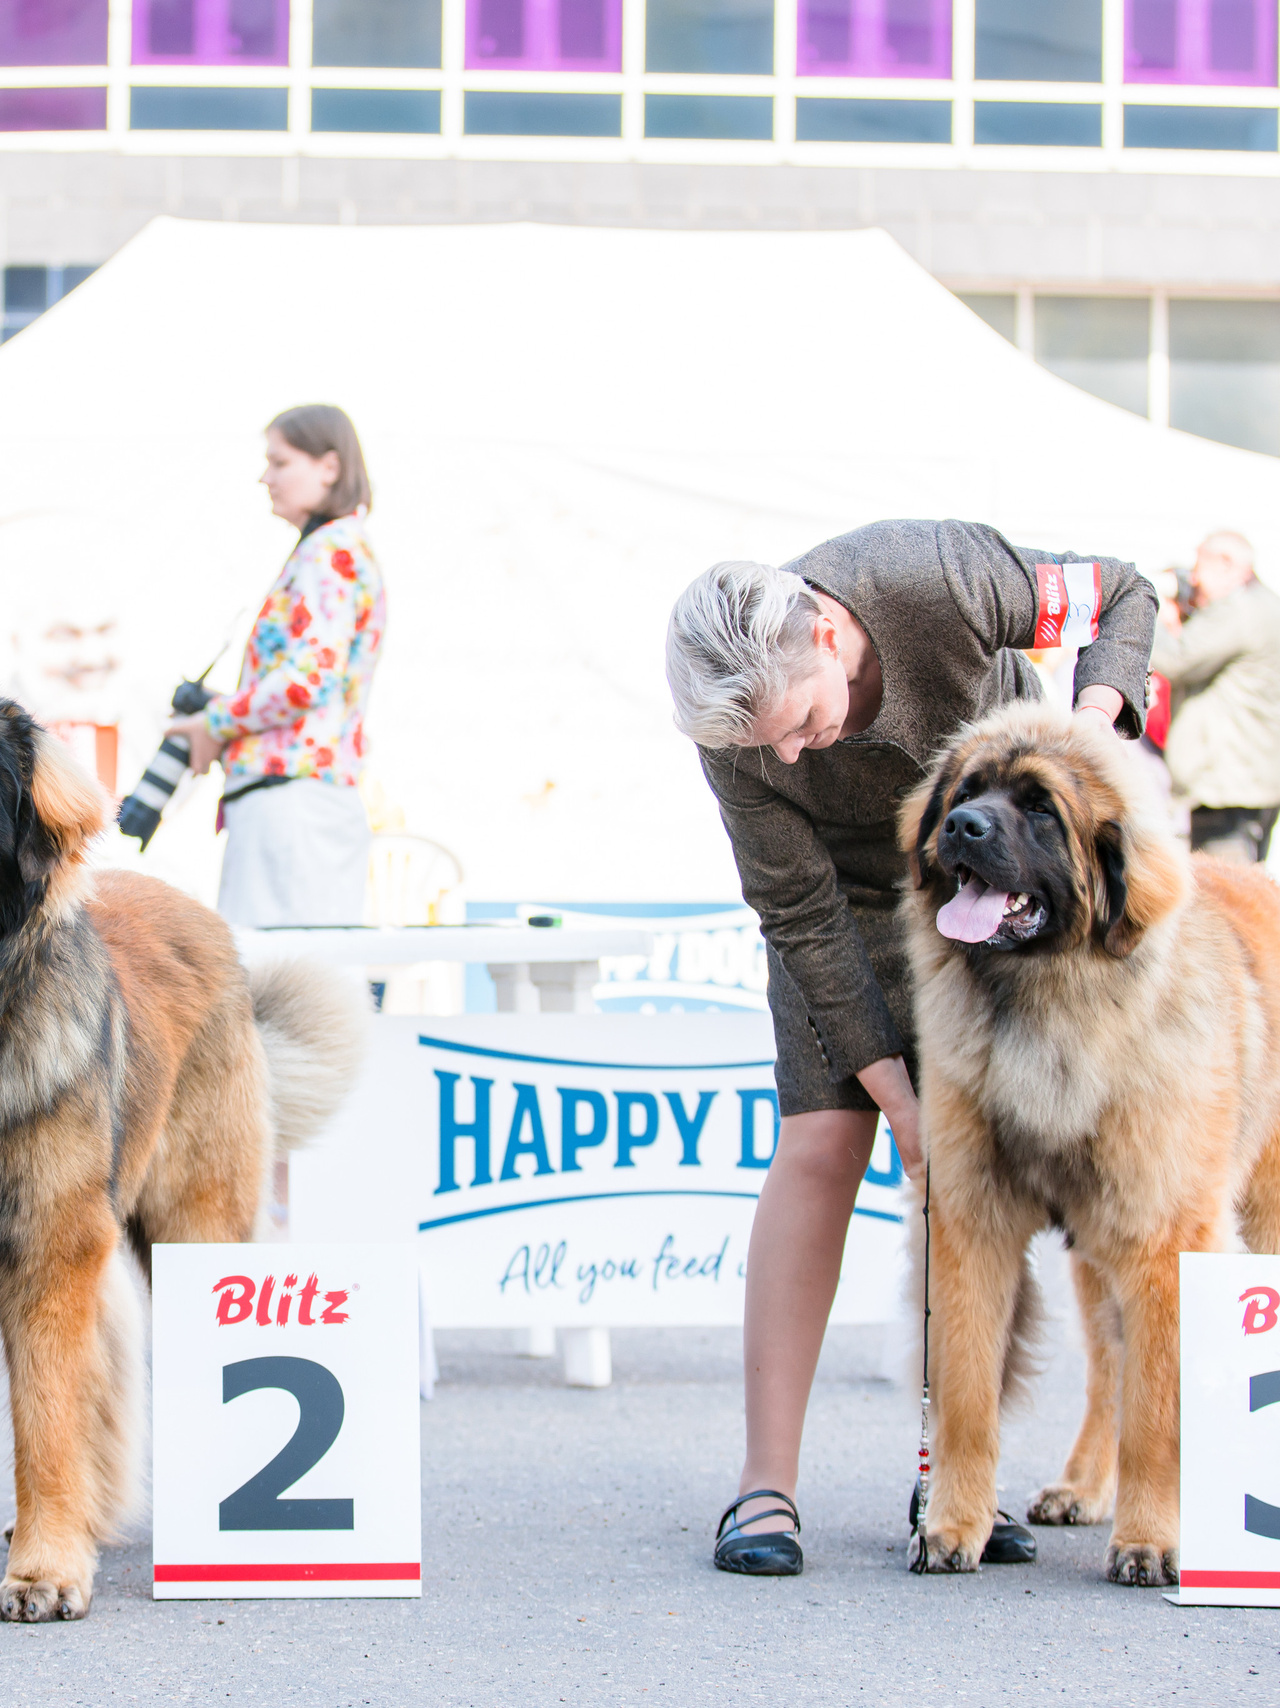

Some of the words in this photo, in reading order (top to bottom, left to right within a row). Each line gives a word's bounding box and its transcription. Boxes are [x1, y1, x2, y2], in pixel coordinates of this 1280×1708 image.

[1045, 572, 1061, 617] Blitz
[433, 1068, 719, 1196] HAPPY
[211, 1271, 352, 1329] Blitz
[498, 1239, 567, 1295] All
[576, 1258, 643, 1305] you
[653, 1233, 730, 1291] feed
[218, 1355, 355, 1532] 2
